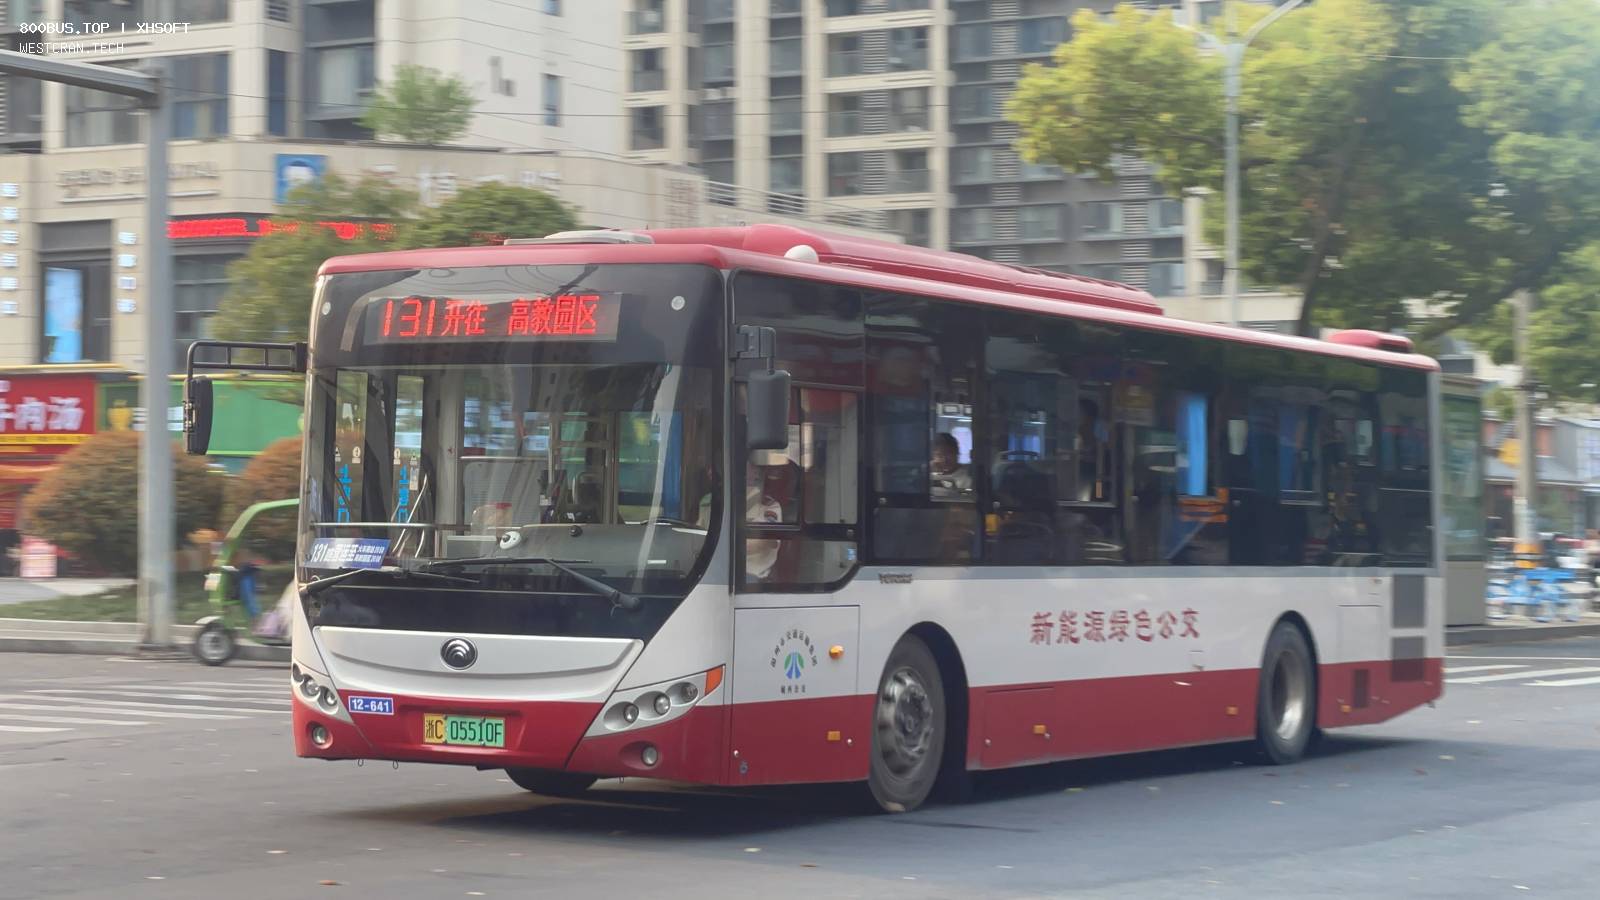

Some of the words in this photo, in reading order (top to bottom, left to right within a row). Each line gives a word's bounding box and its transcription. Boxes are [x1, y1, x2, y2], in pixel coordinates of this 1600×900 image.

[507, 295, 600, 336] 高教园区
[1030, 608, 1200, 645] 新能源绿色公交
[351, 699, 390, 713] 12-641
[425, 719, 444, 740] 浙C
[449, 721, 503, 743] 05510F
